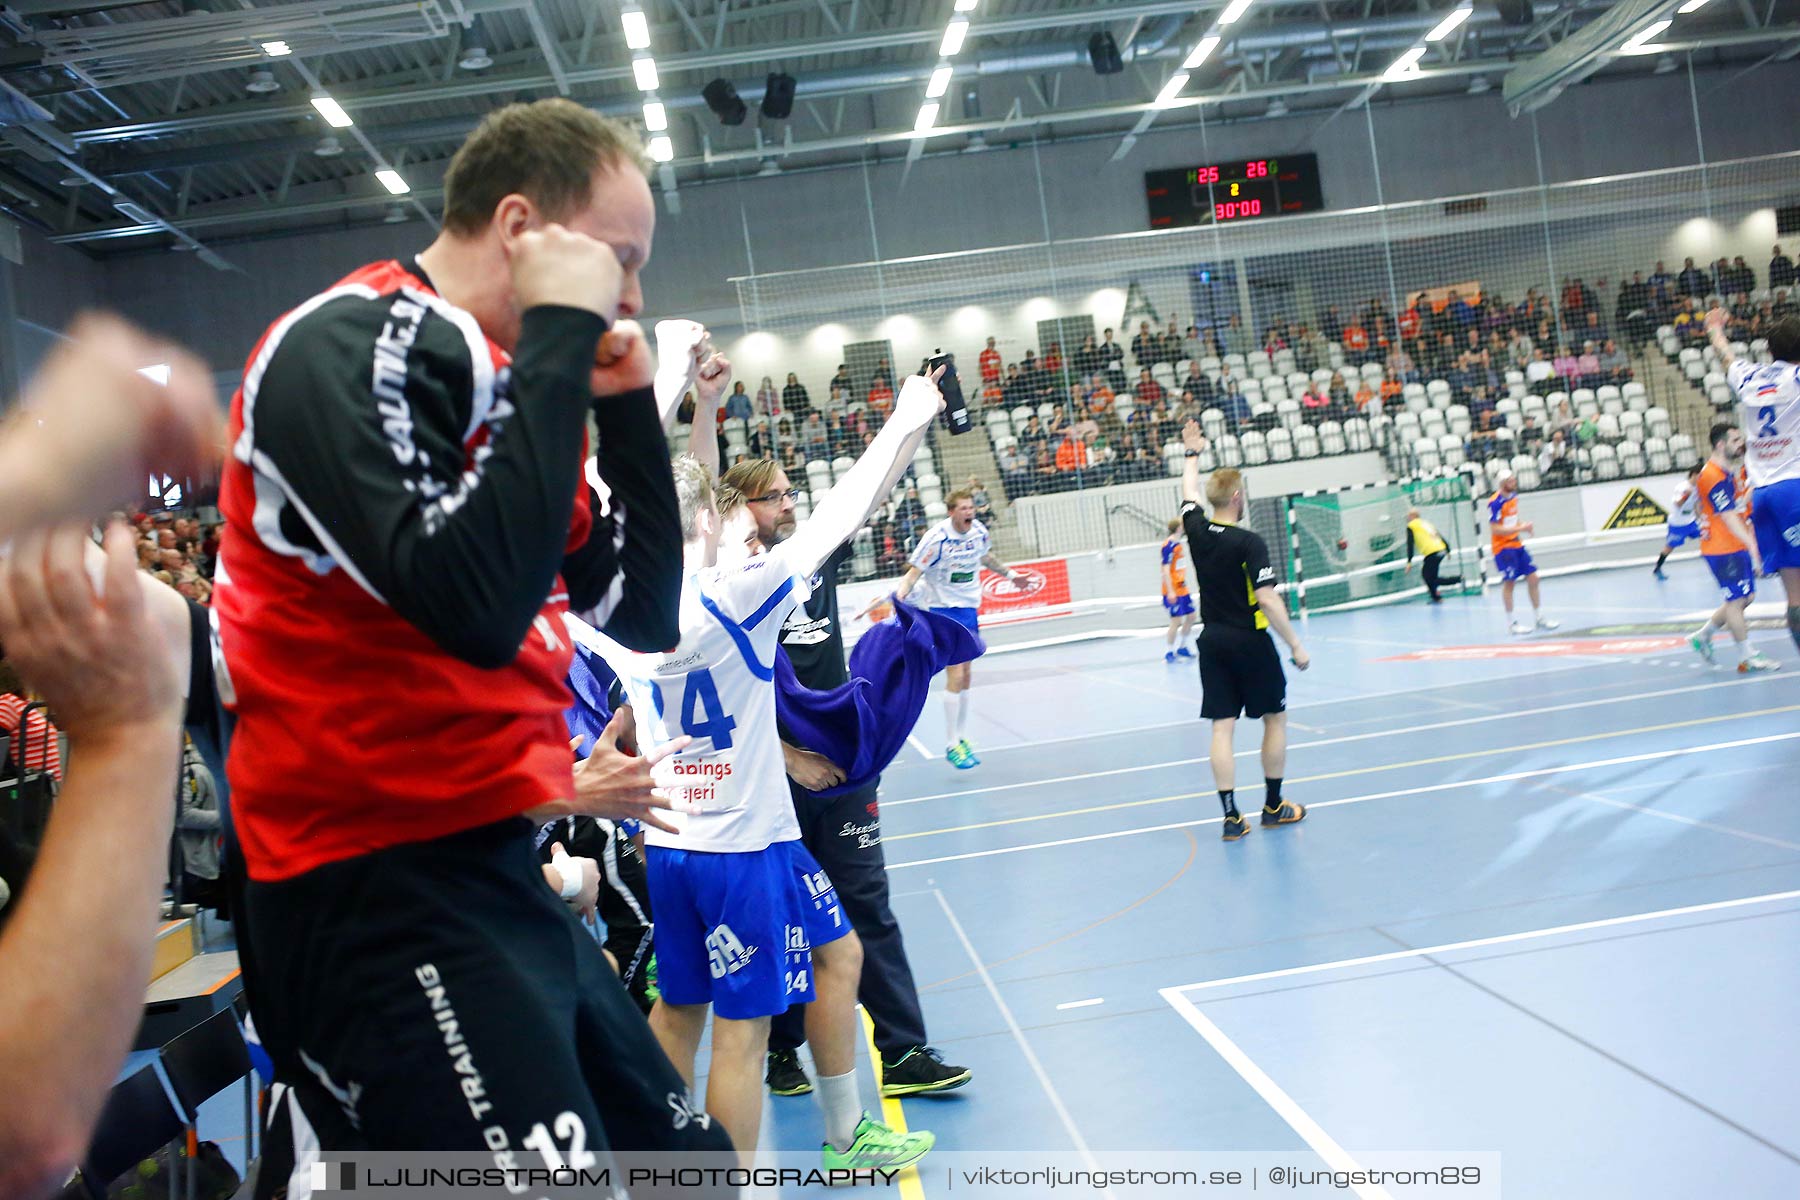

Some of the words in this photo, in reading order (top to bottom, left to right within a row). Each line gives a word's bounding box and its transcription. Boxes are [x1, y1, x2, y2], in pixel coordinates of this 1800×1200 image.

[1198, 166, 1219, 184] 25
[1246, 160, 1267, 178] 26
[1230, 183, 1240, 196] 2
[828, 905, 843, 928] 7
[414, 962, 493, 1122] TRAINING
[521, 1110, 597, 1181] 12
